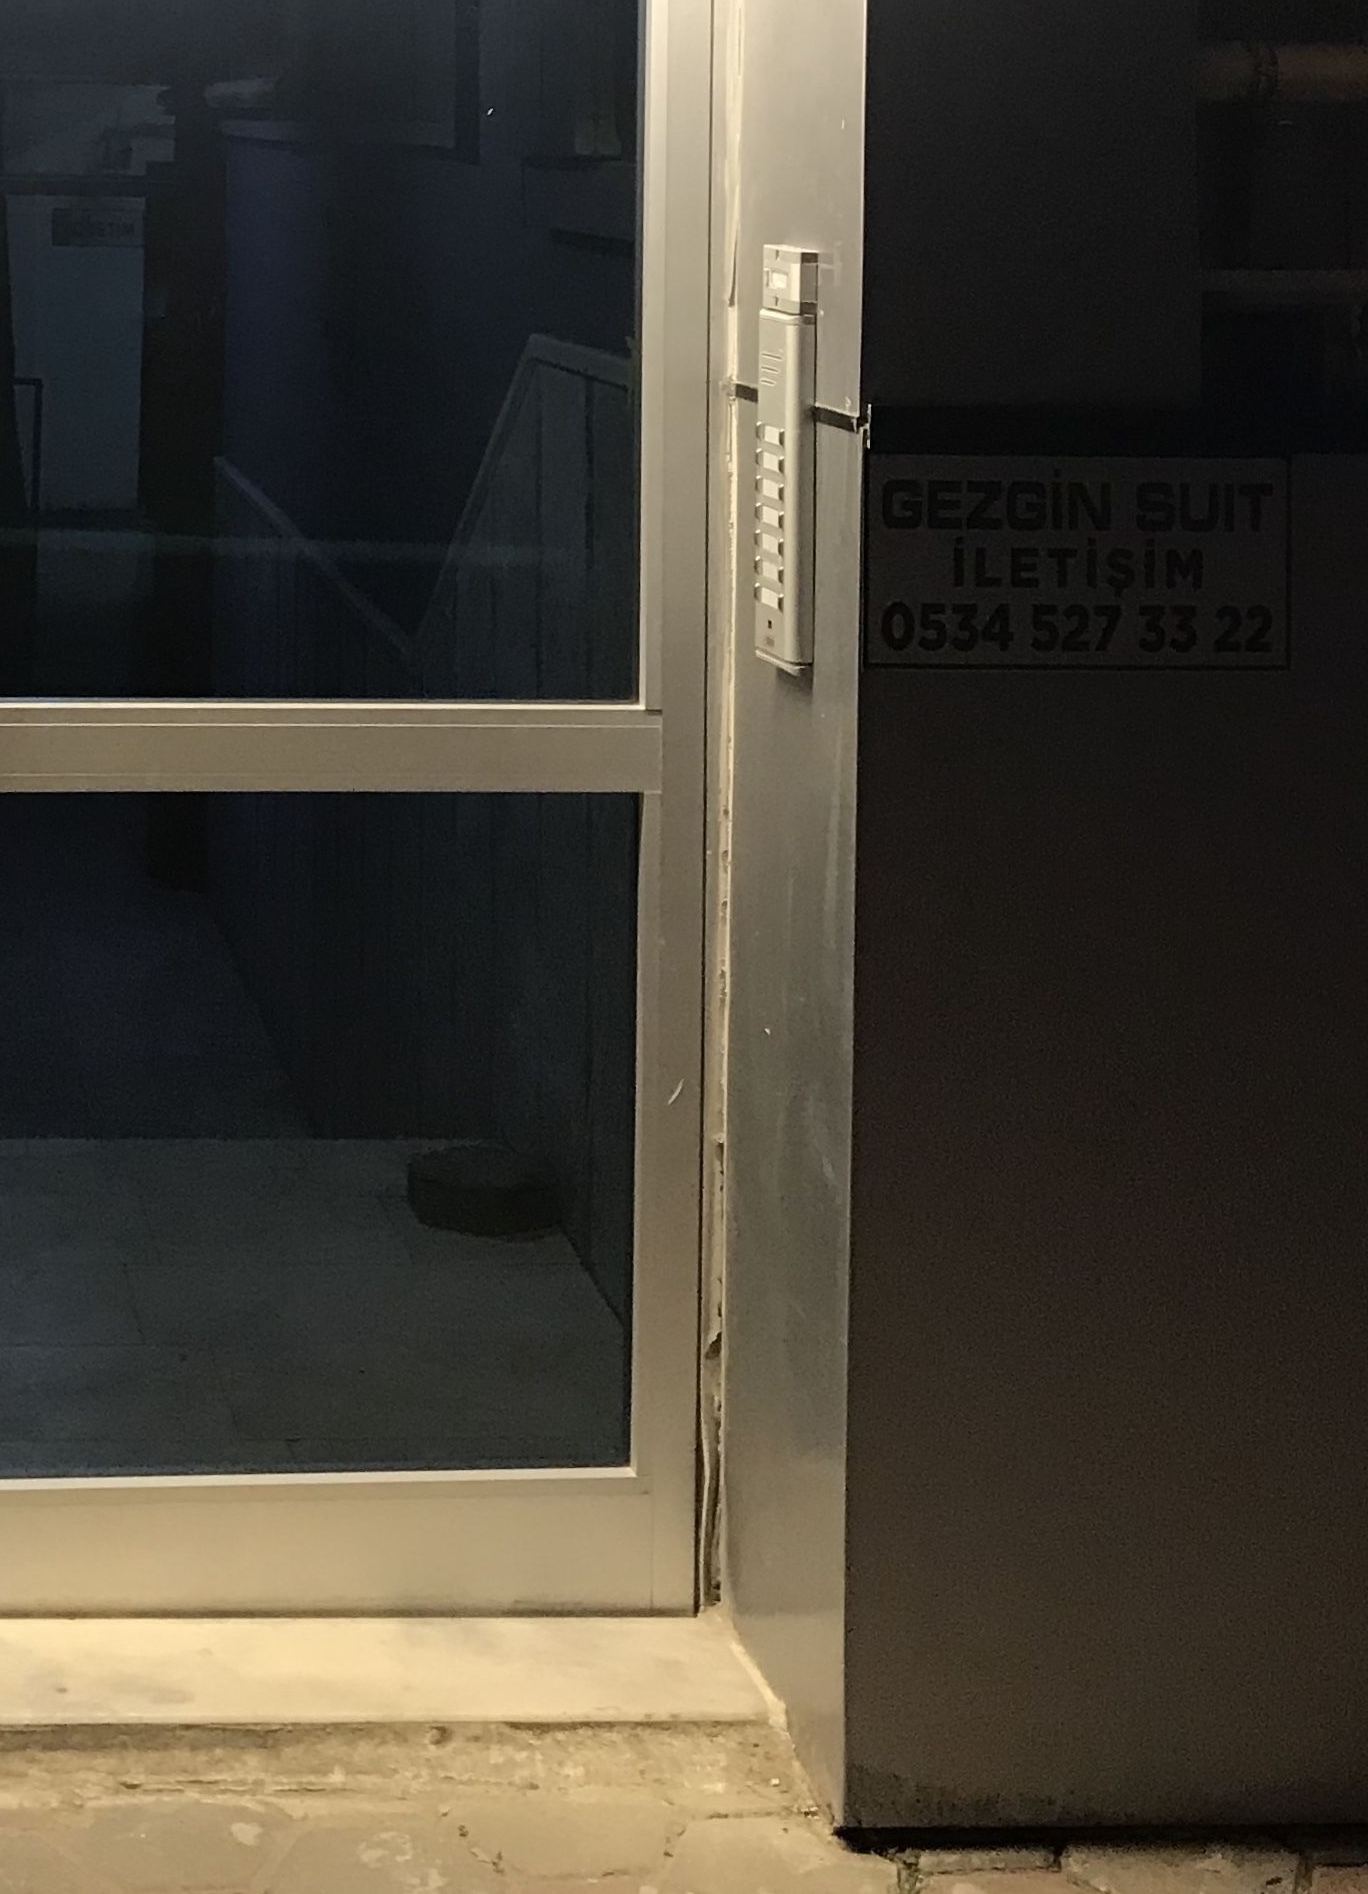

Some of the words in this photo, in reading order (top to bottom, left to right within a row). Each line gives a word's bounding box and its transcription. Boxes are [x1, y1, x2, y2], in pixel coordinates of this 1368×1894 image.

[880, 468, 1112, 532] GEZGİN
[1135, 481, 1274, 533] SUIT
[952, 536, 1205, 598] İLETİŞİM
[880, 600, 1015, 653] 0534
[1030, 602, 1123, 654] 527
[1137, 603, 1198, 654] 33
[1213, 604, 1274, 654] 22
